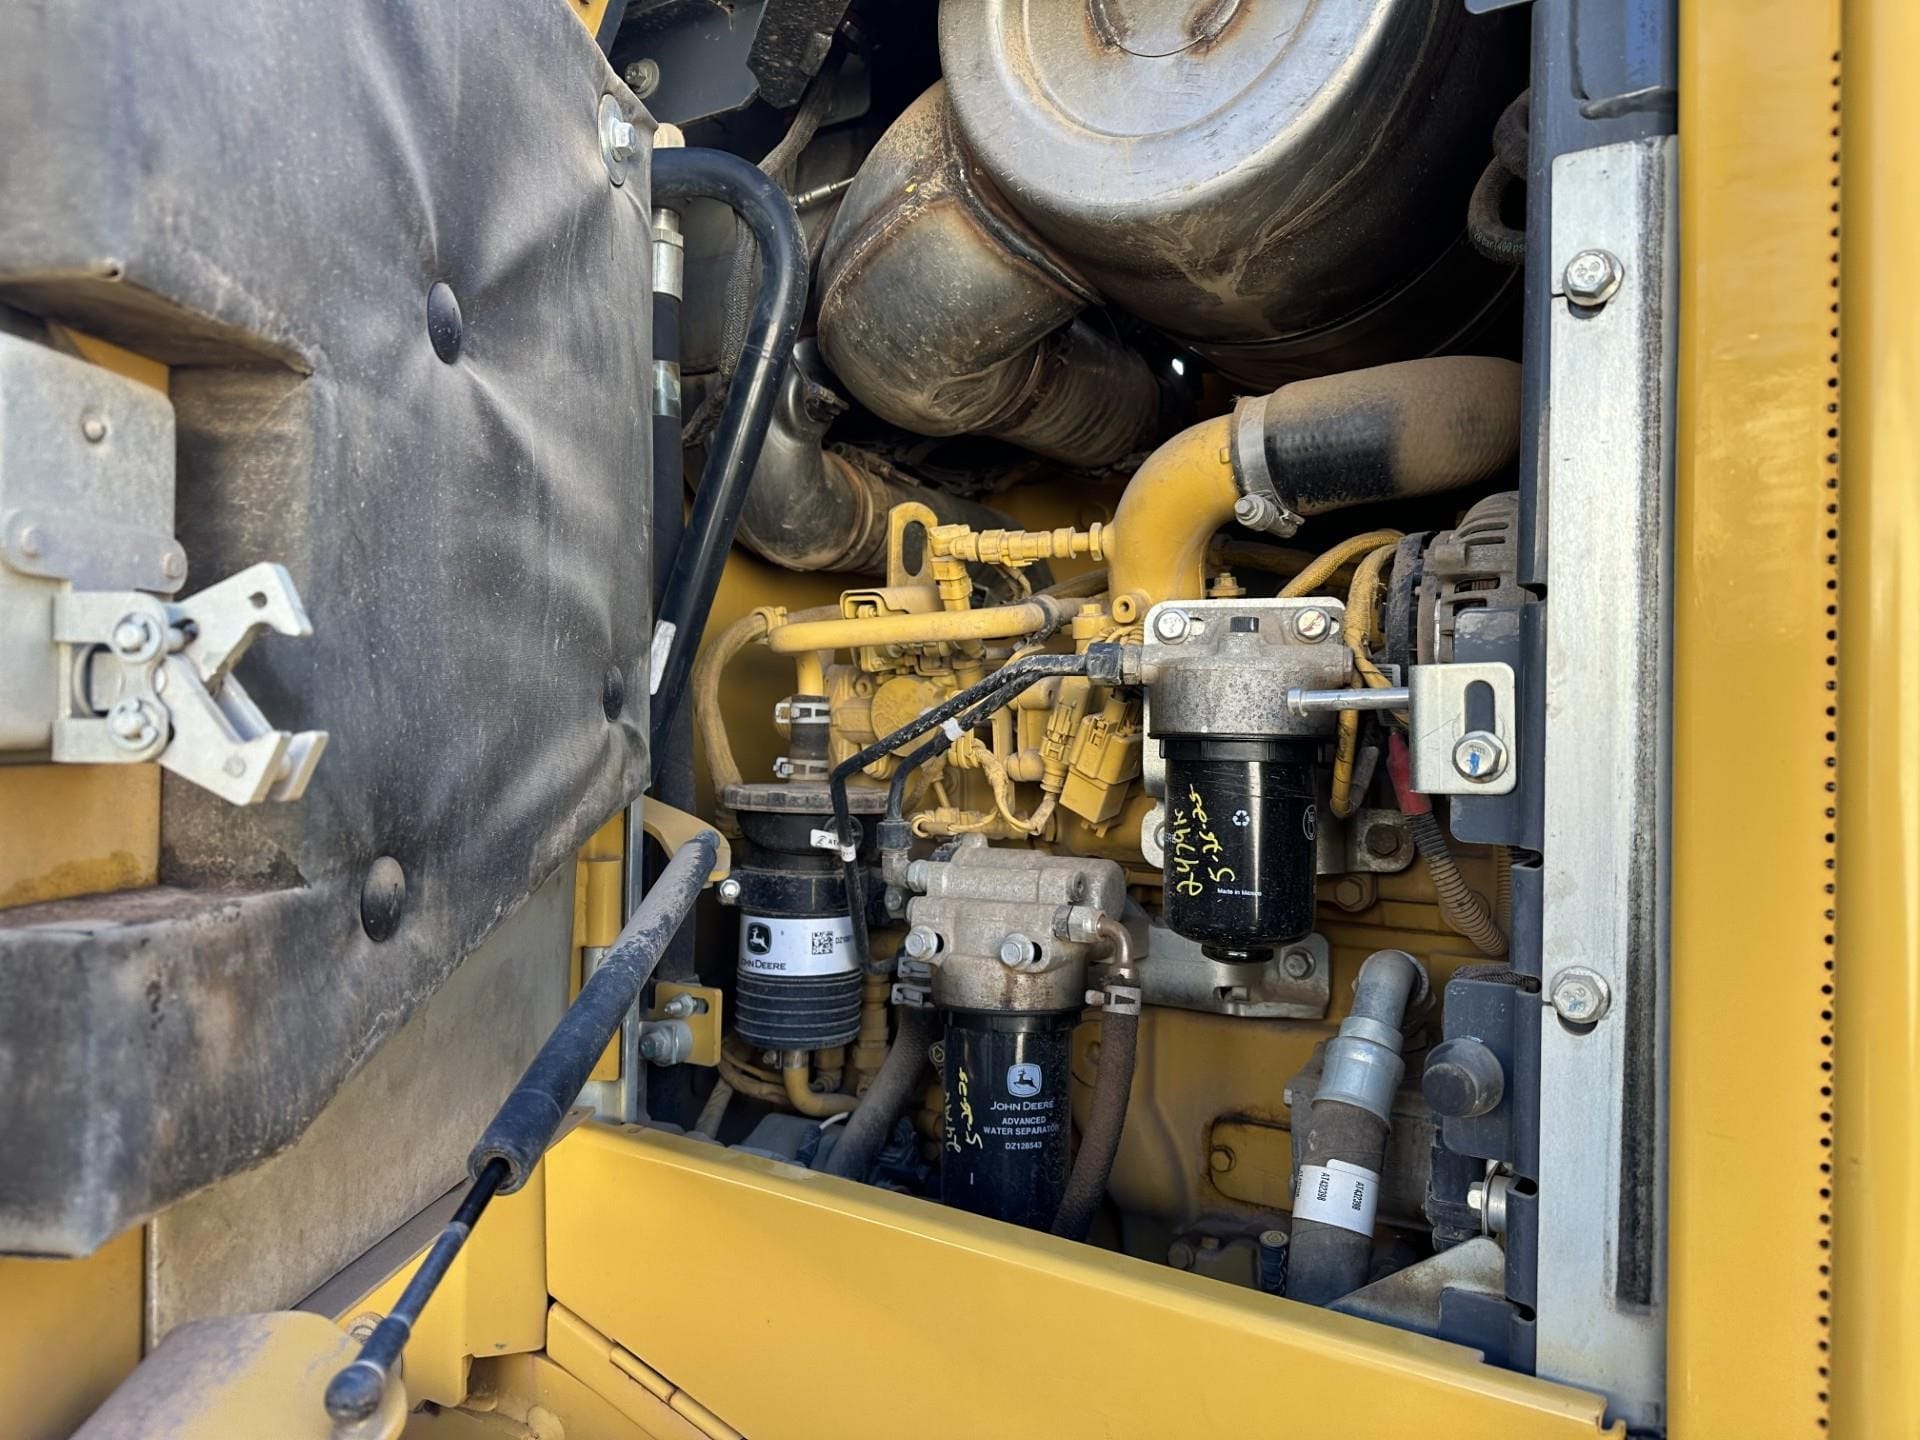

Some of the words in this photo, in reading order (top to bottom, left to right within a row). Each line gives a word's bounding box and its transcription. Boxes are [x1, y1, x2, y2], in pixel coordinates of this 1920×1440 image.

[1217, 887, 1234, 895] Made
[755, 959, 787, 971] DEERE
[990, 1101, 1021, 1111] JOHN
[1022, 1100, 1055, 1111] DEERE
[1002, 1115, 1047, 1125] ADVANCED
[983, 1126, 1013, 1136] WATER
[1005, 1140, 1043, 1151] DZ128543
